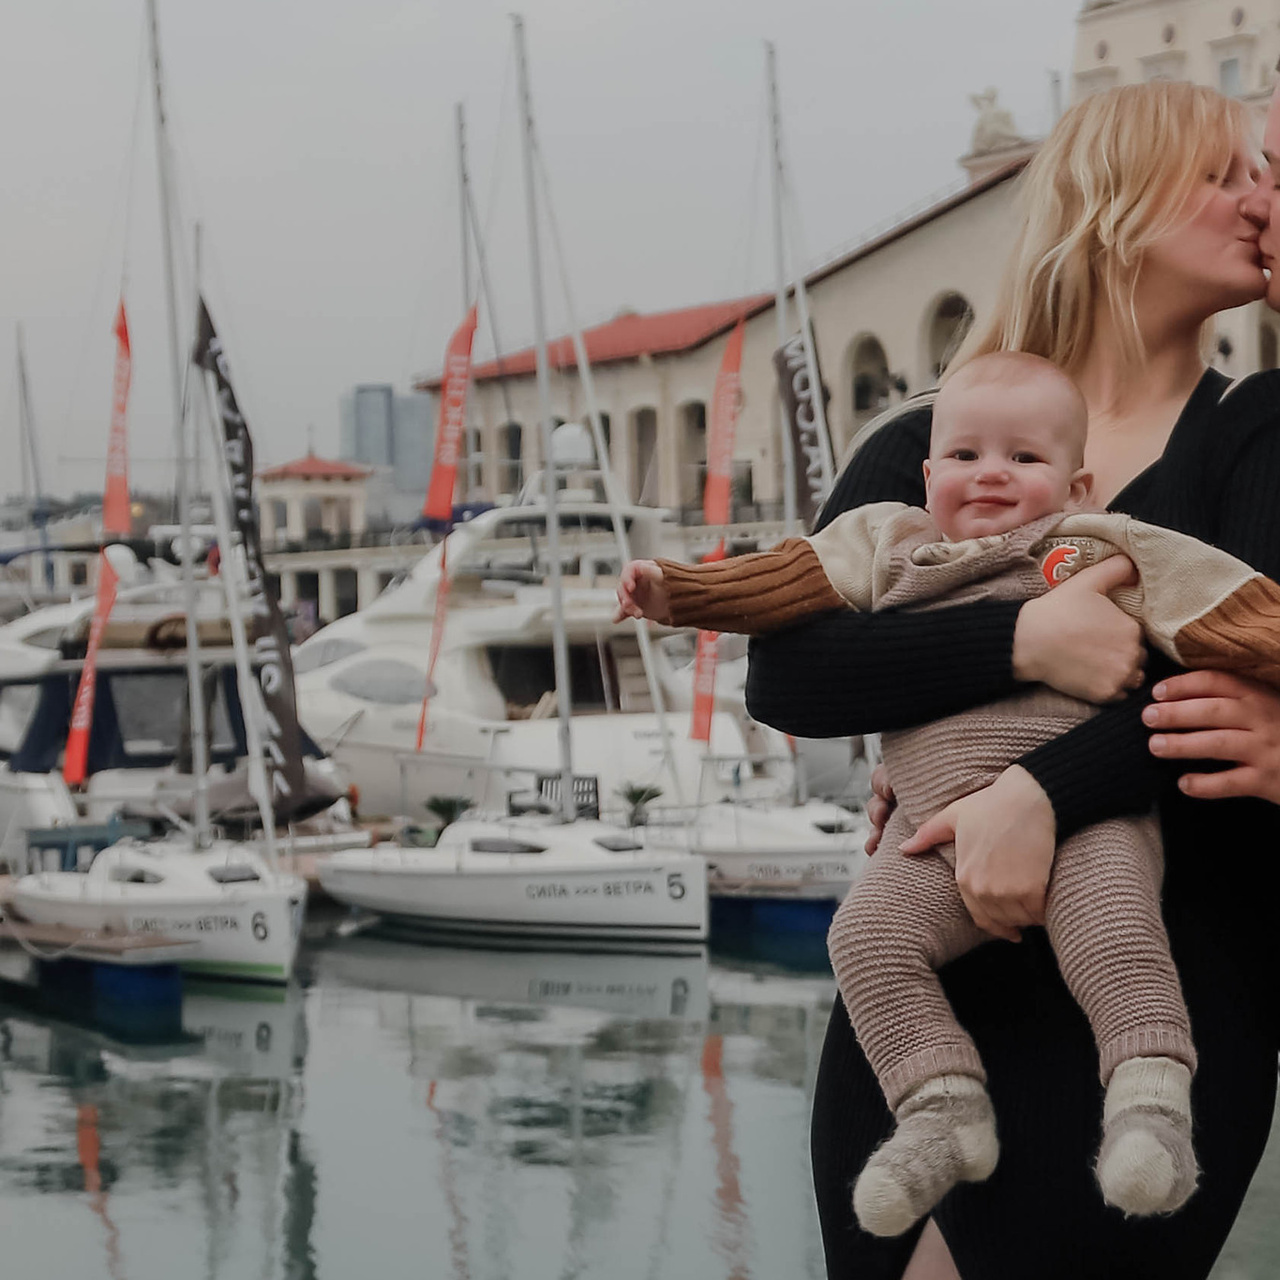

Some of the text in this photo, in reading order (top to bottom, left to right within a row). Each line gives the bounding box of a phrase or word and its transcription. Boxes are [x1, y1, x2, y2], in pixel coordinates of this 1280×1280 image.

[526, 880, 654, 899] СИЛА ВЕТРА
[667, 872, 686, 900] 5
[252, 911, 268, 941] 6
